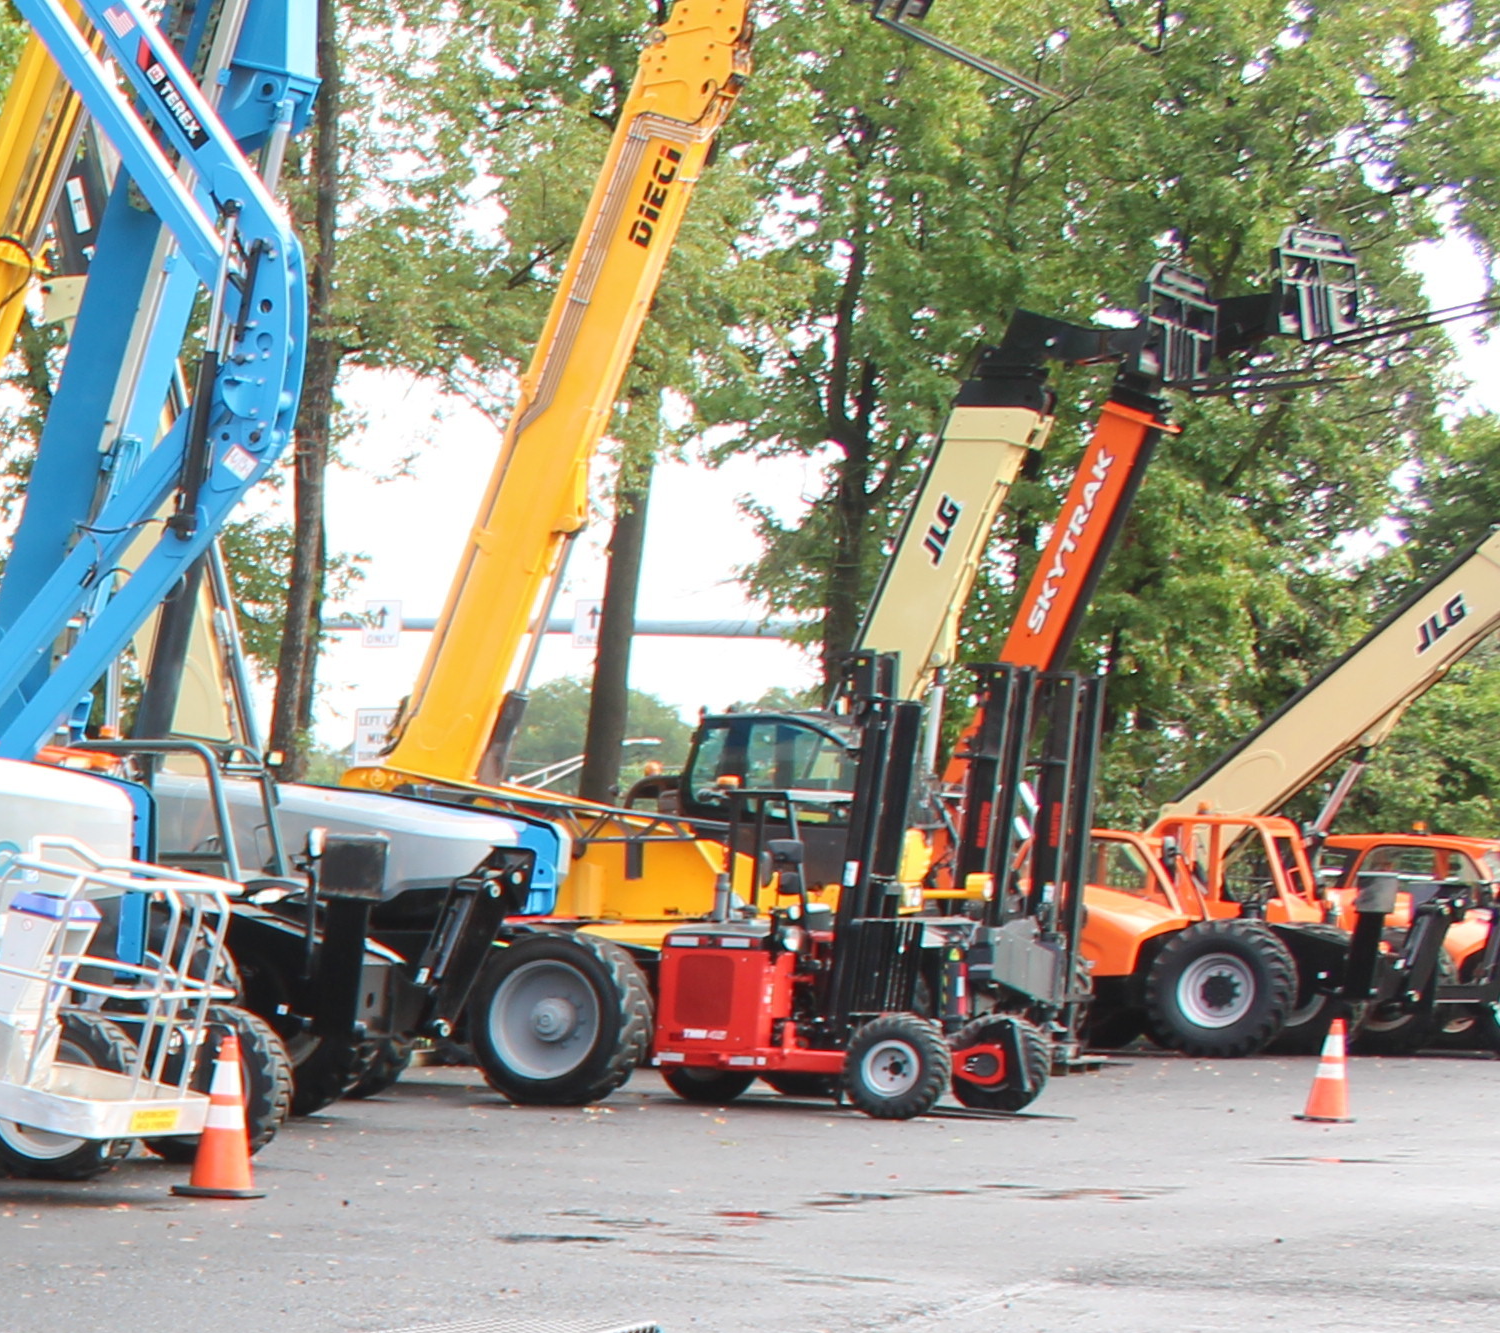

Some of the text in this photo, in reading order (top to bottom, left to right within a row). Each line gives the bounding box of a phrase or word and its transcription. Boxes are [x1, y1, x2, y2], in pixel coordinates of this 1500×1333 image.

[159, 81, 201, 139] TEREX
[628, 145, 682, 249] DIECI
[921, 492, 962, 569] JLG
[1027, 448, 1114, 634] SKYTRAK
[1414, 591, 1467, 656] JLG
